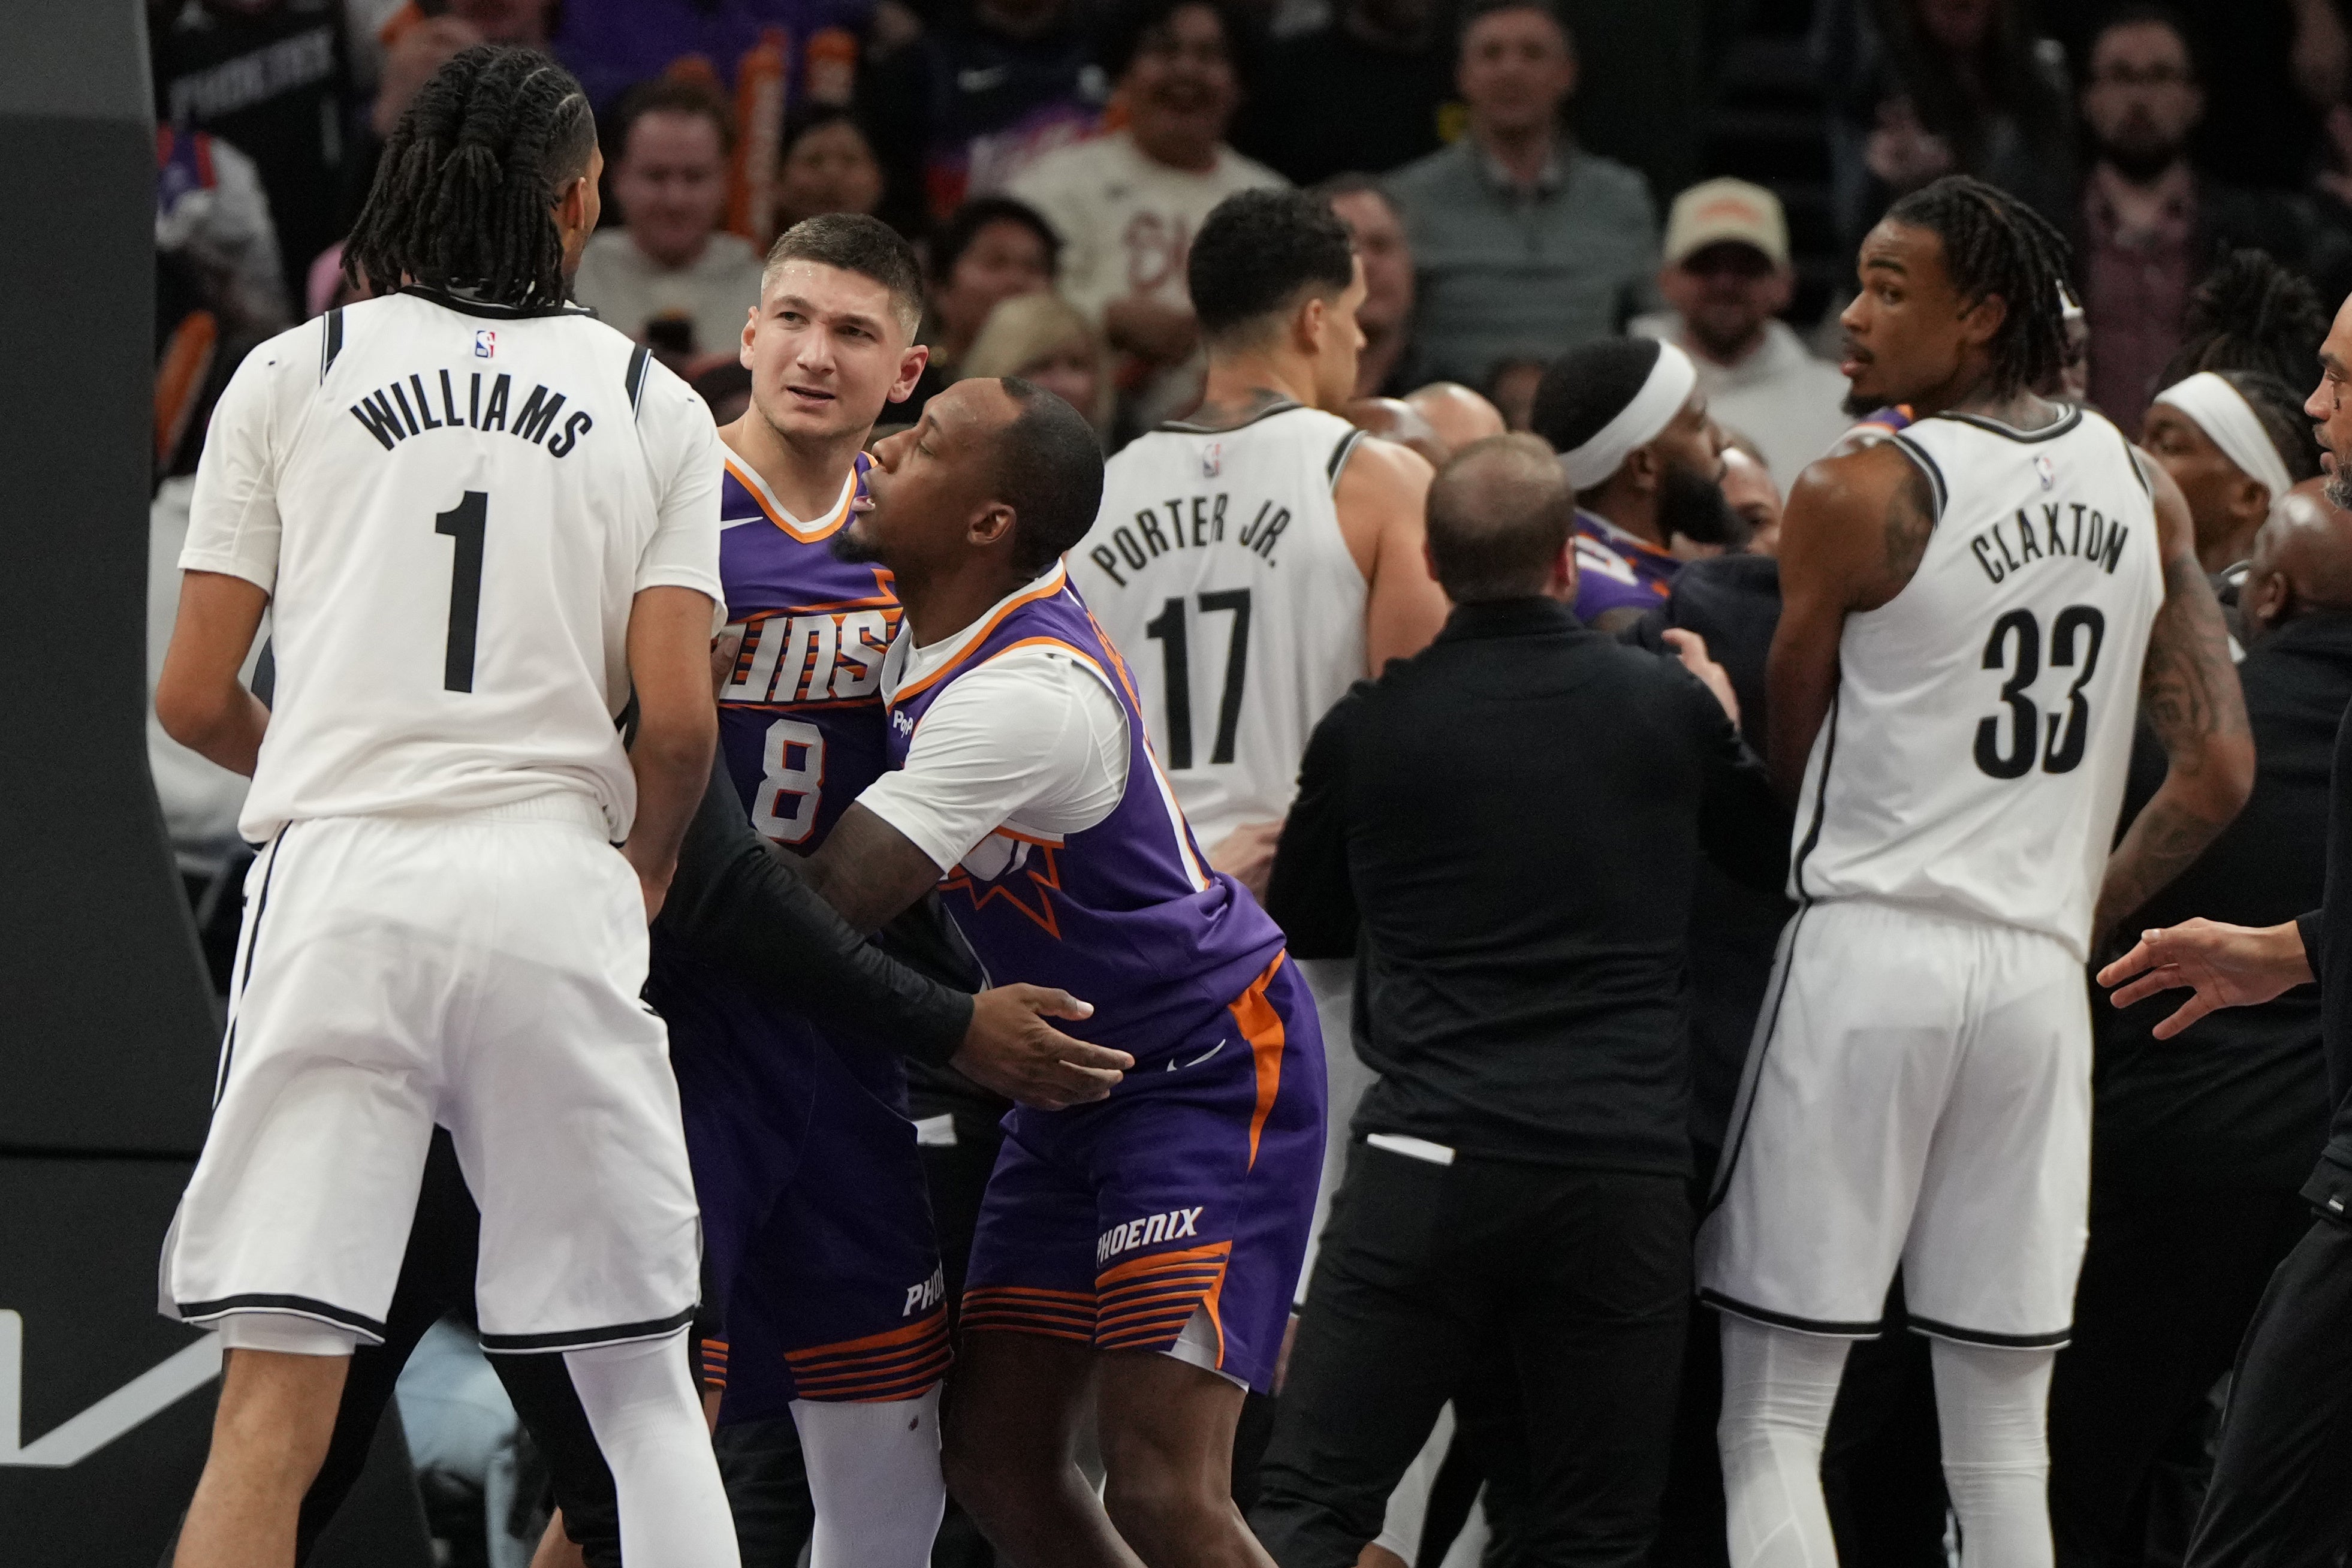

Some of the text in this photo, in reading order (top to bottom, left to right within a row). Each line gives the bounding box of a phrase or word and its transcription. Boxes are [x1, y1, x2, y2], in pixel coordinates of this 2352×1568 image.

[349, 369, 593, 459] WILLIAMS
[1089, 492, 1292, 588] PORTER JR.
[1971, 503, 2129, 584] CLAXTON
[435, 490, 488, 693] 1
[719, 610, 886, 702] UNS
[1145, 587, 1252, 771] 17
[1973, 604, 2106, 780] 33
[751, 718, 826, 843] 8
[1096, 1206, 1204, 1269] PHOENIX
